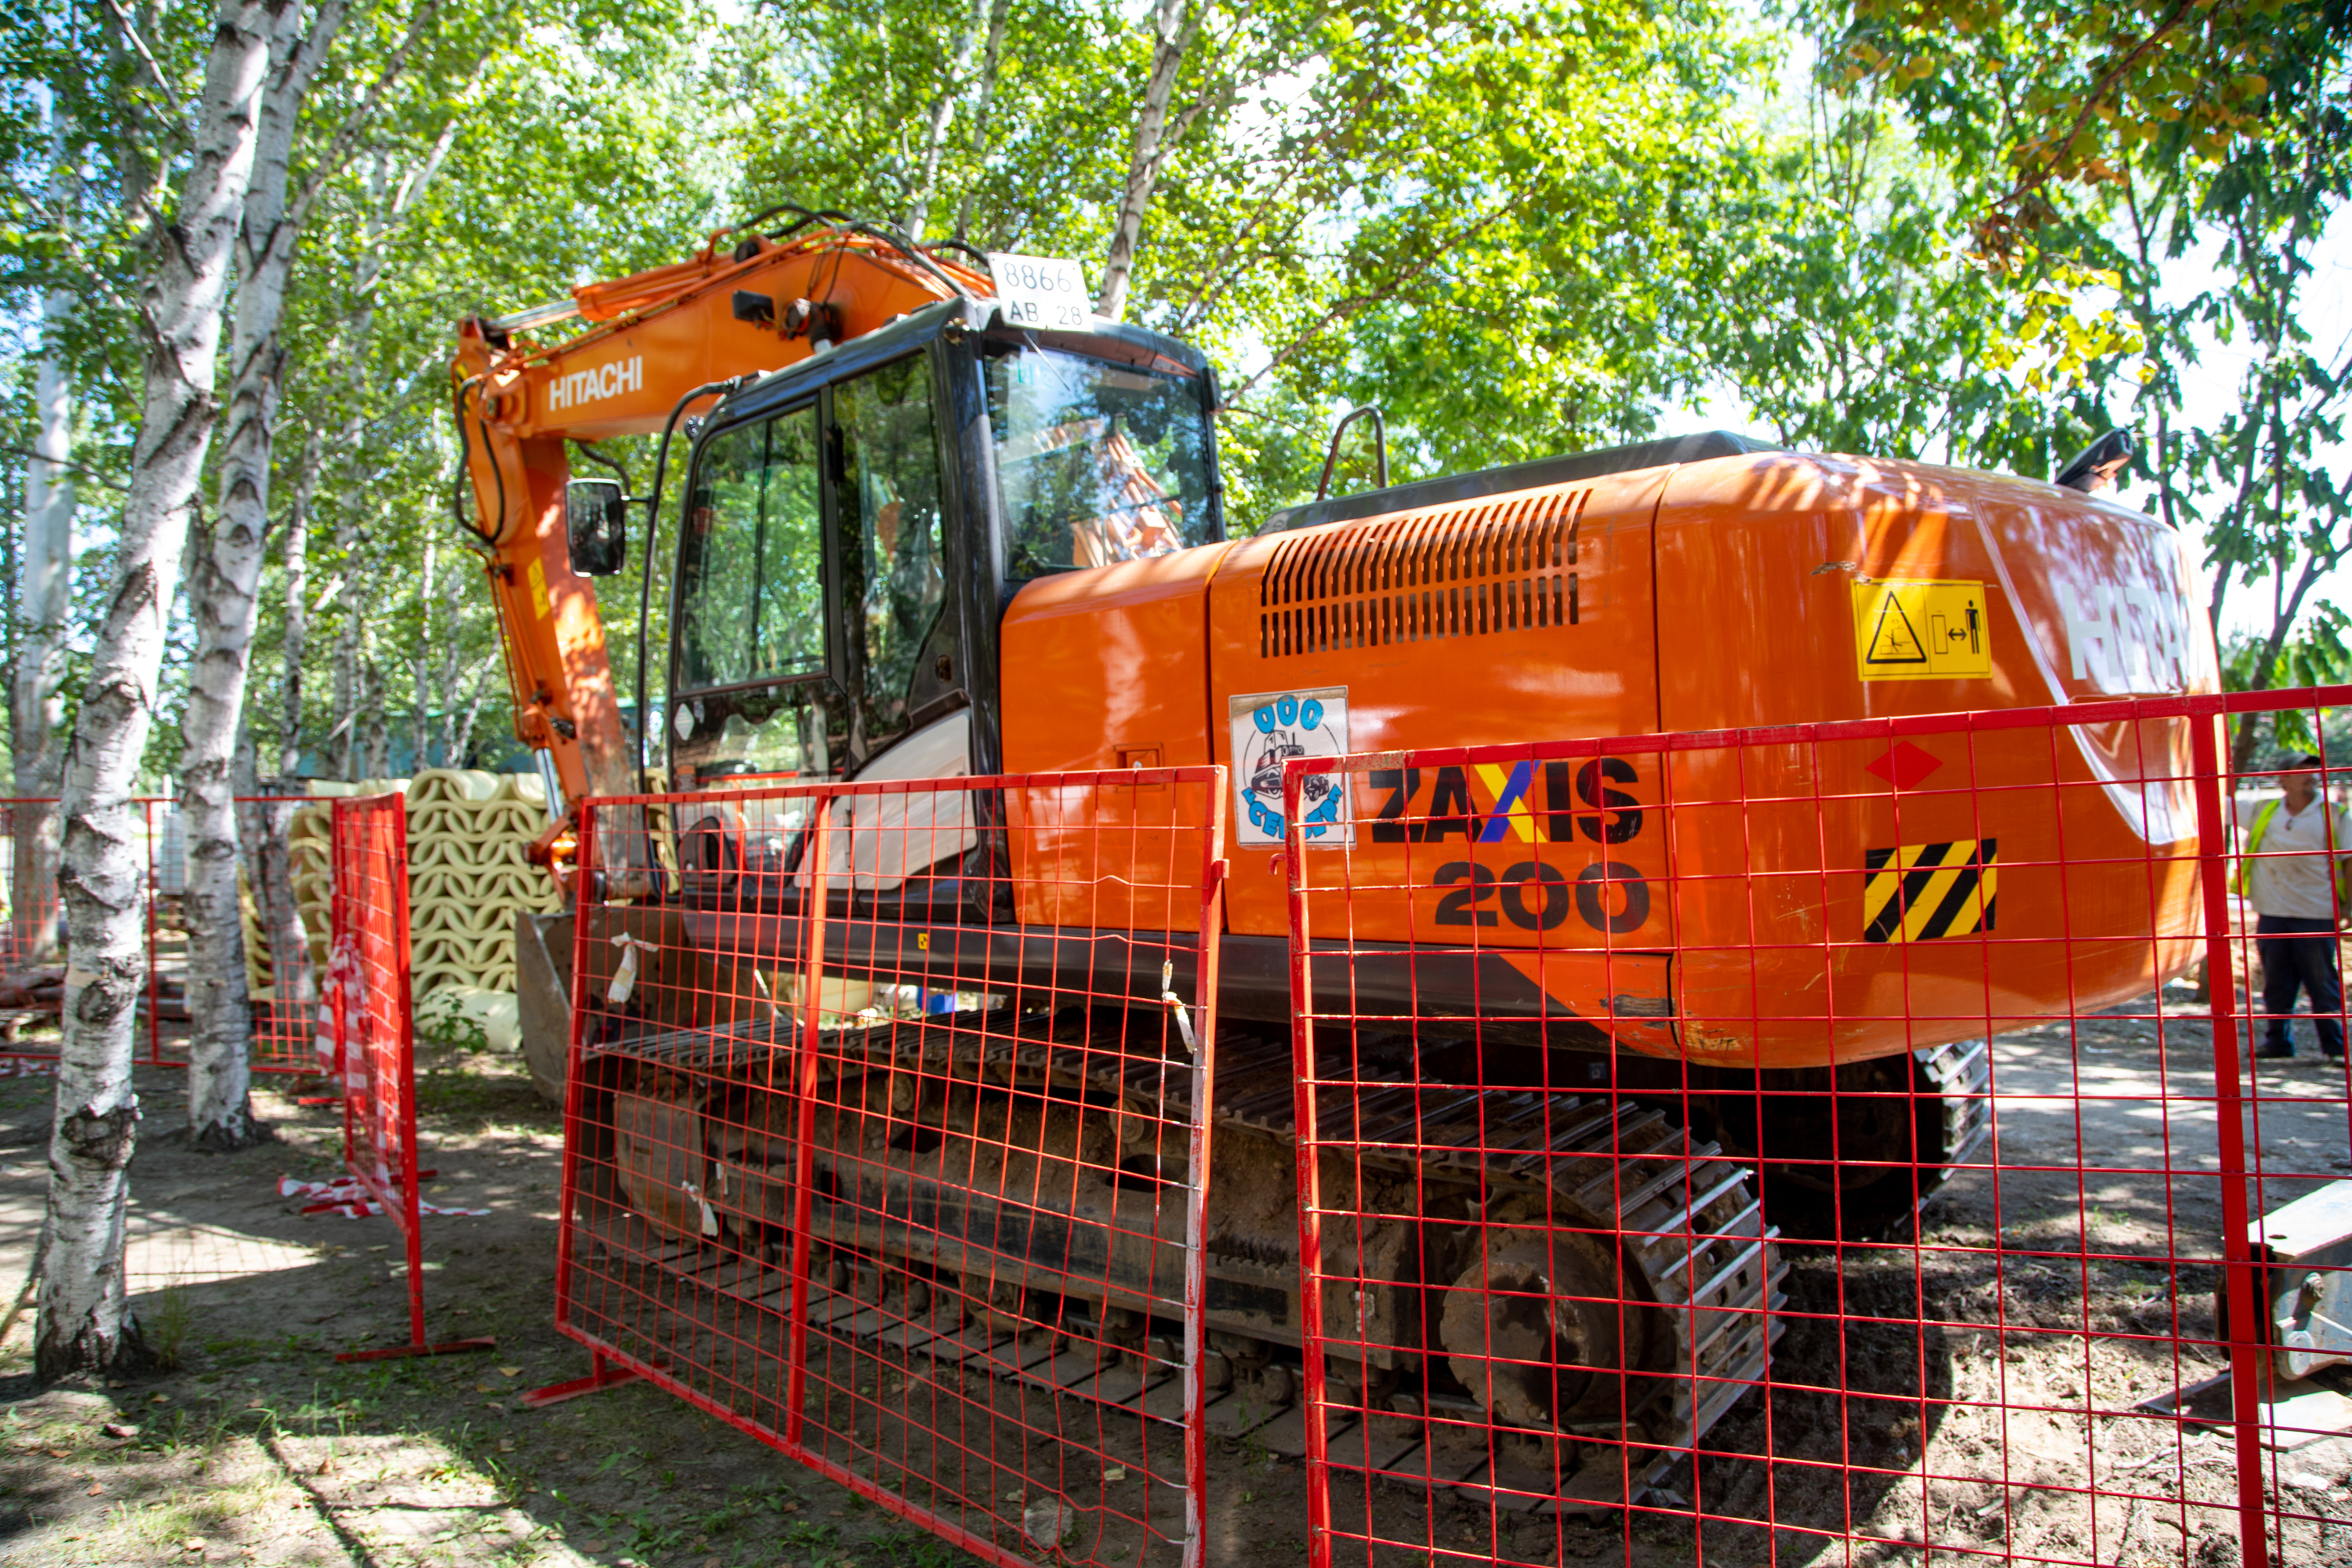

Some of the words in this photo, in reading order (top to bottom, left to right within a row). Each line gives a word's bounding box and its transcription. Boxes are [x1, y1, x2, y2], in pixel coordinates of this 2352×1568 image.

[1004, 262, 1072, 292] 8866
[1056, 305, 1083, 325] 28
[549, 355, 643, 412] HITACHI
[1369, 757, 1643, 844] ZAXIS
[1432, 860, 1651, 935] 200
